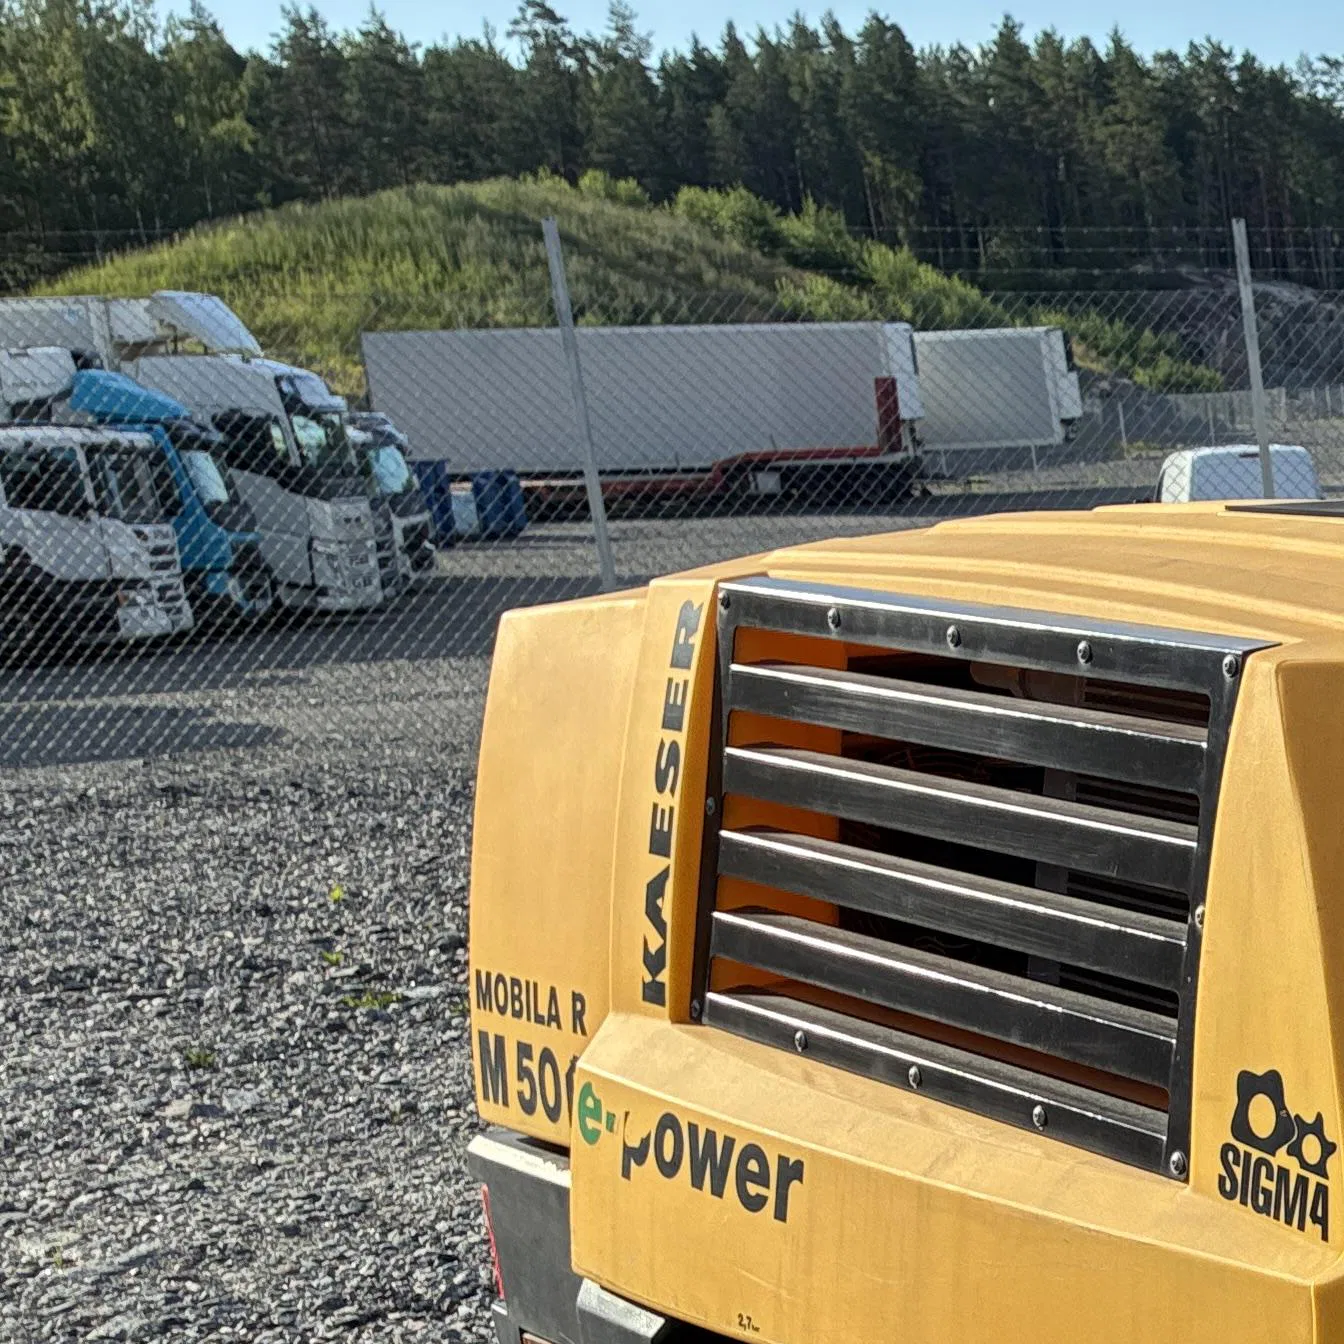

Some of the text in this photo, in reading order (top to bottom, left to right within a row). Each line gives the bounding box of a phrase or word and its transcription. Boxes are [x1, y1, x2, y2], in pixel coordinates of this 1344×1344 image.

[642, 600, 704, 1007] KAESER
[475, 968, 587, 1037] MOBILA R
[1218, 1143, 1329, 1243] SIGMA
